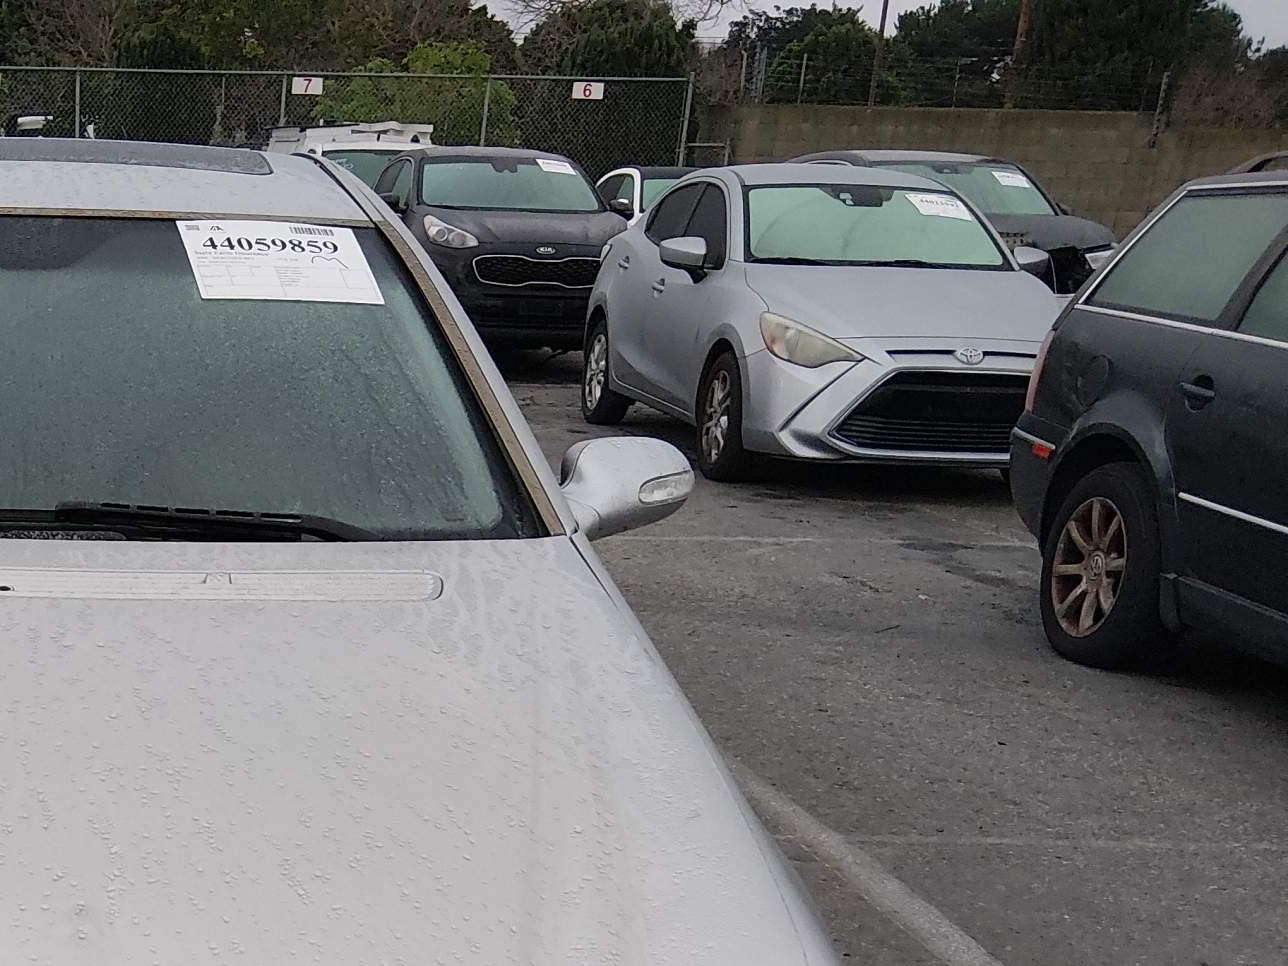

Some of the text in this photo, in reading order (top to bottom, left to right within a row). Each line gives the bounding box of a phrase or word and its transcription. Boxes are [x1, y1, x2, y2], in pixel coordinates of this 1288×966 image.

[303, 78, 313, 93] 7
[583, 83, 592, 97] 6
[202, 236, 339, 255] 44059859
